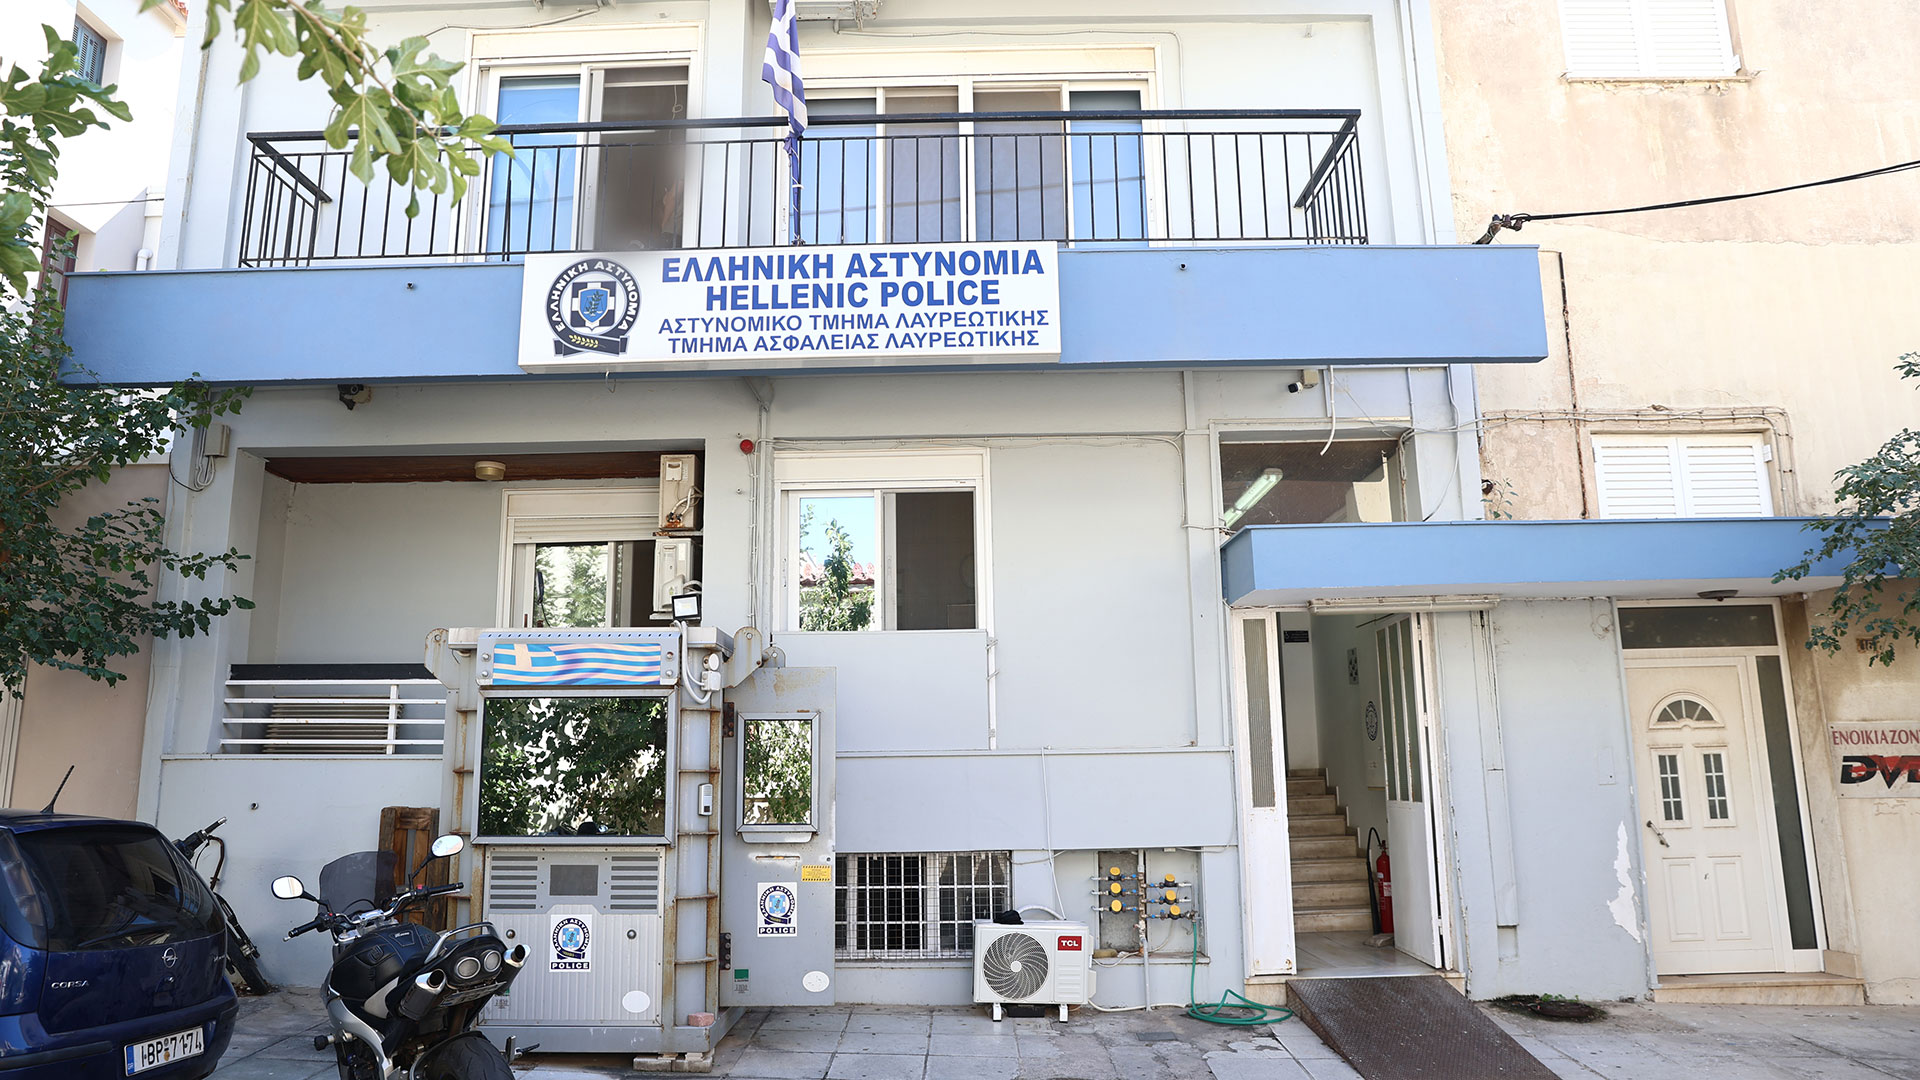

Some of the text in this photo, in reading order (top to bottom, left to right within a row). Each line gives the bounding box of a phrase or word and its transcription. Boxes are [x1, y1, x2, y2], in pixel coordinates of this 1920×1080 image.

[662, 249, 1044, 283] ΕΛΛΗΝΙΚΗ ΑΣΤΥΝΟΜΙΑ
[550, 261, 638, 332] ΕΛΛΗΝΙΚΗ ΑΣΤΥΝΟΜΙΑ
[706, 280, 1000, 311] HELLENIC POLICE
[658, 310, 1049, 334] ΑΣΤΥΝΟΜΙΚΟ ΤΜΗΜΑ ΛΑΥΡΕΩΤΙΚΗΣ
[668, 330, 1039, 354] ΤΜΗΜΑ ΑΣΦΑΛΕΙΑΣ ΛΑΥΡΕΩΤΙΚΗΣ
[1832, 729, 1920, 746] ΕΝΟΙΚΙΑΖΟΝ
[51, 980, 89, 989] CORSA
